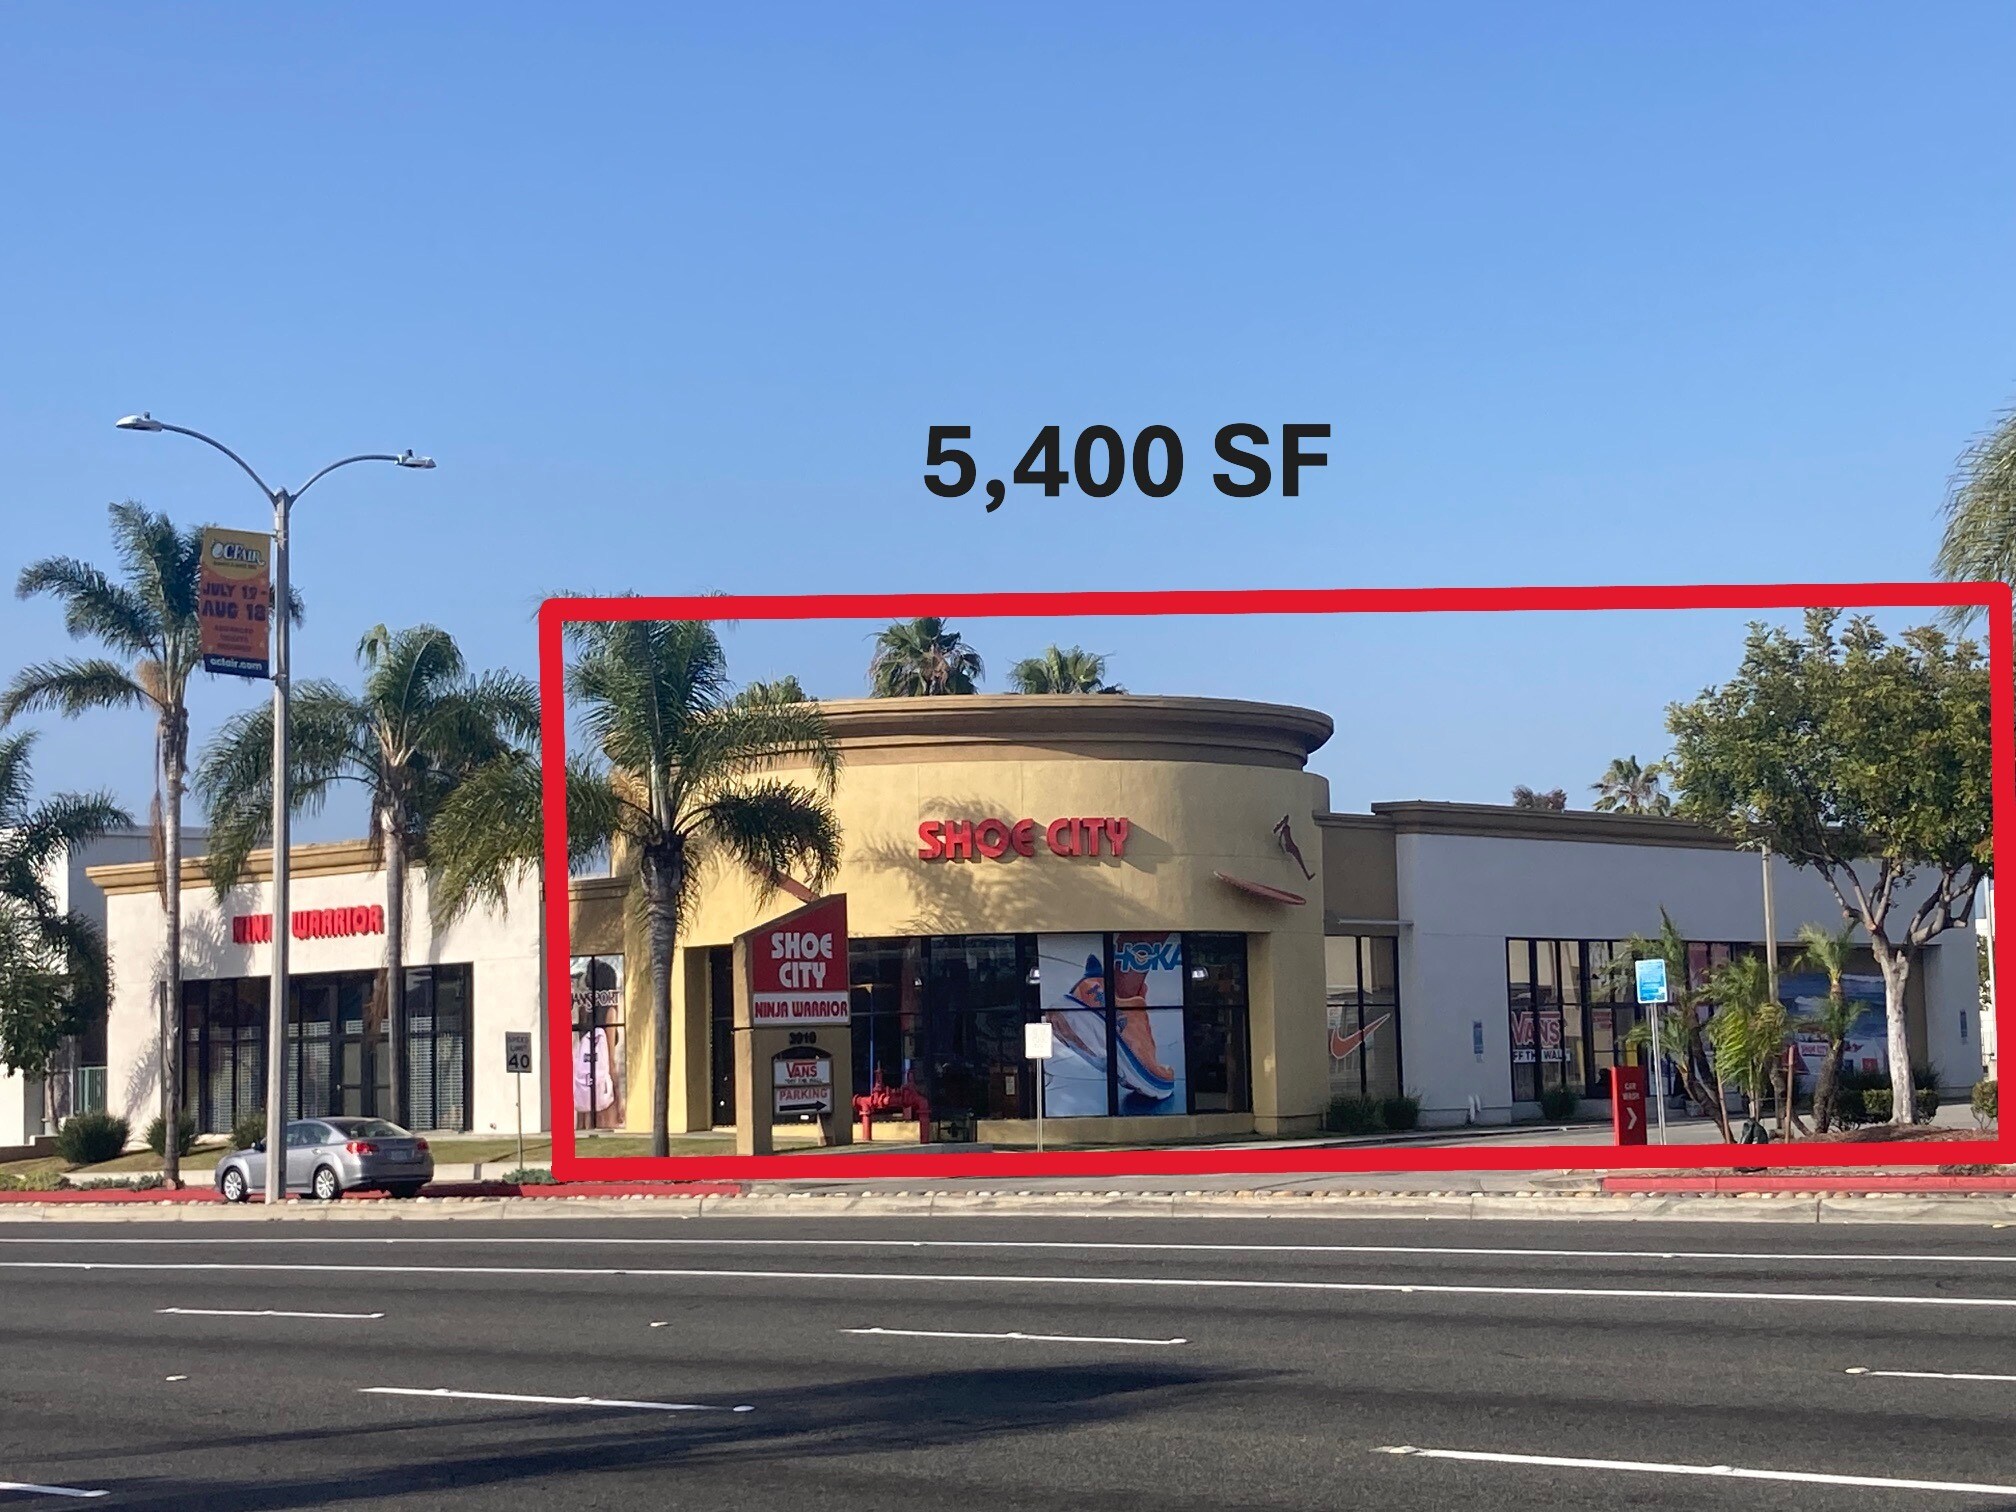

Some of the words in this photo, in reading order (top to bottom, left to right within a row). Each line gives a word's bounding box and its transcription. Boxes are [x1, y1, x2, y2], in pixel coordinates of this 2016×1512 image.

[202, 582, 237, 598] JULY
[202, 601, 238, 619] AUG
[209, 657, 263, 671] ocfair.com
[918, 817, 1035, 860] SHOE
[1046, 817, 1129, 857] CITY
[232, 914, 273, 944] NINJ
[292, 904, 385, 940] WARRIOR
[771, 932, 833, 959] SHOE
[779, 961, 826, 988] CITY
[754, 1001, 788, 1018] NINJA
[791, 1000, 848, 1018] WARRIOR
[1511, 1011, 1561, 1046] VANS
[508, 1054, 530, 1069] 40
[786, 1060, 818, 1078] VANS
[779, 1087, 828, 1101] PARKING
